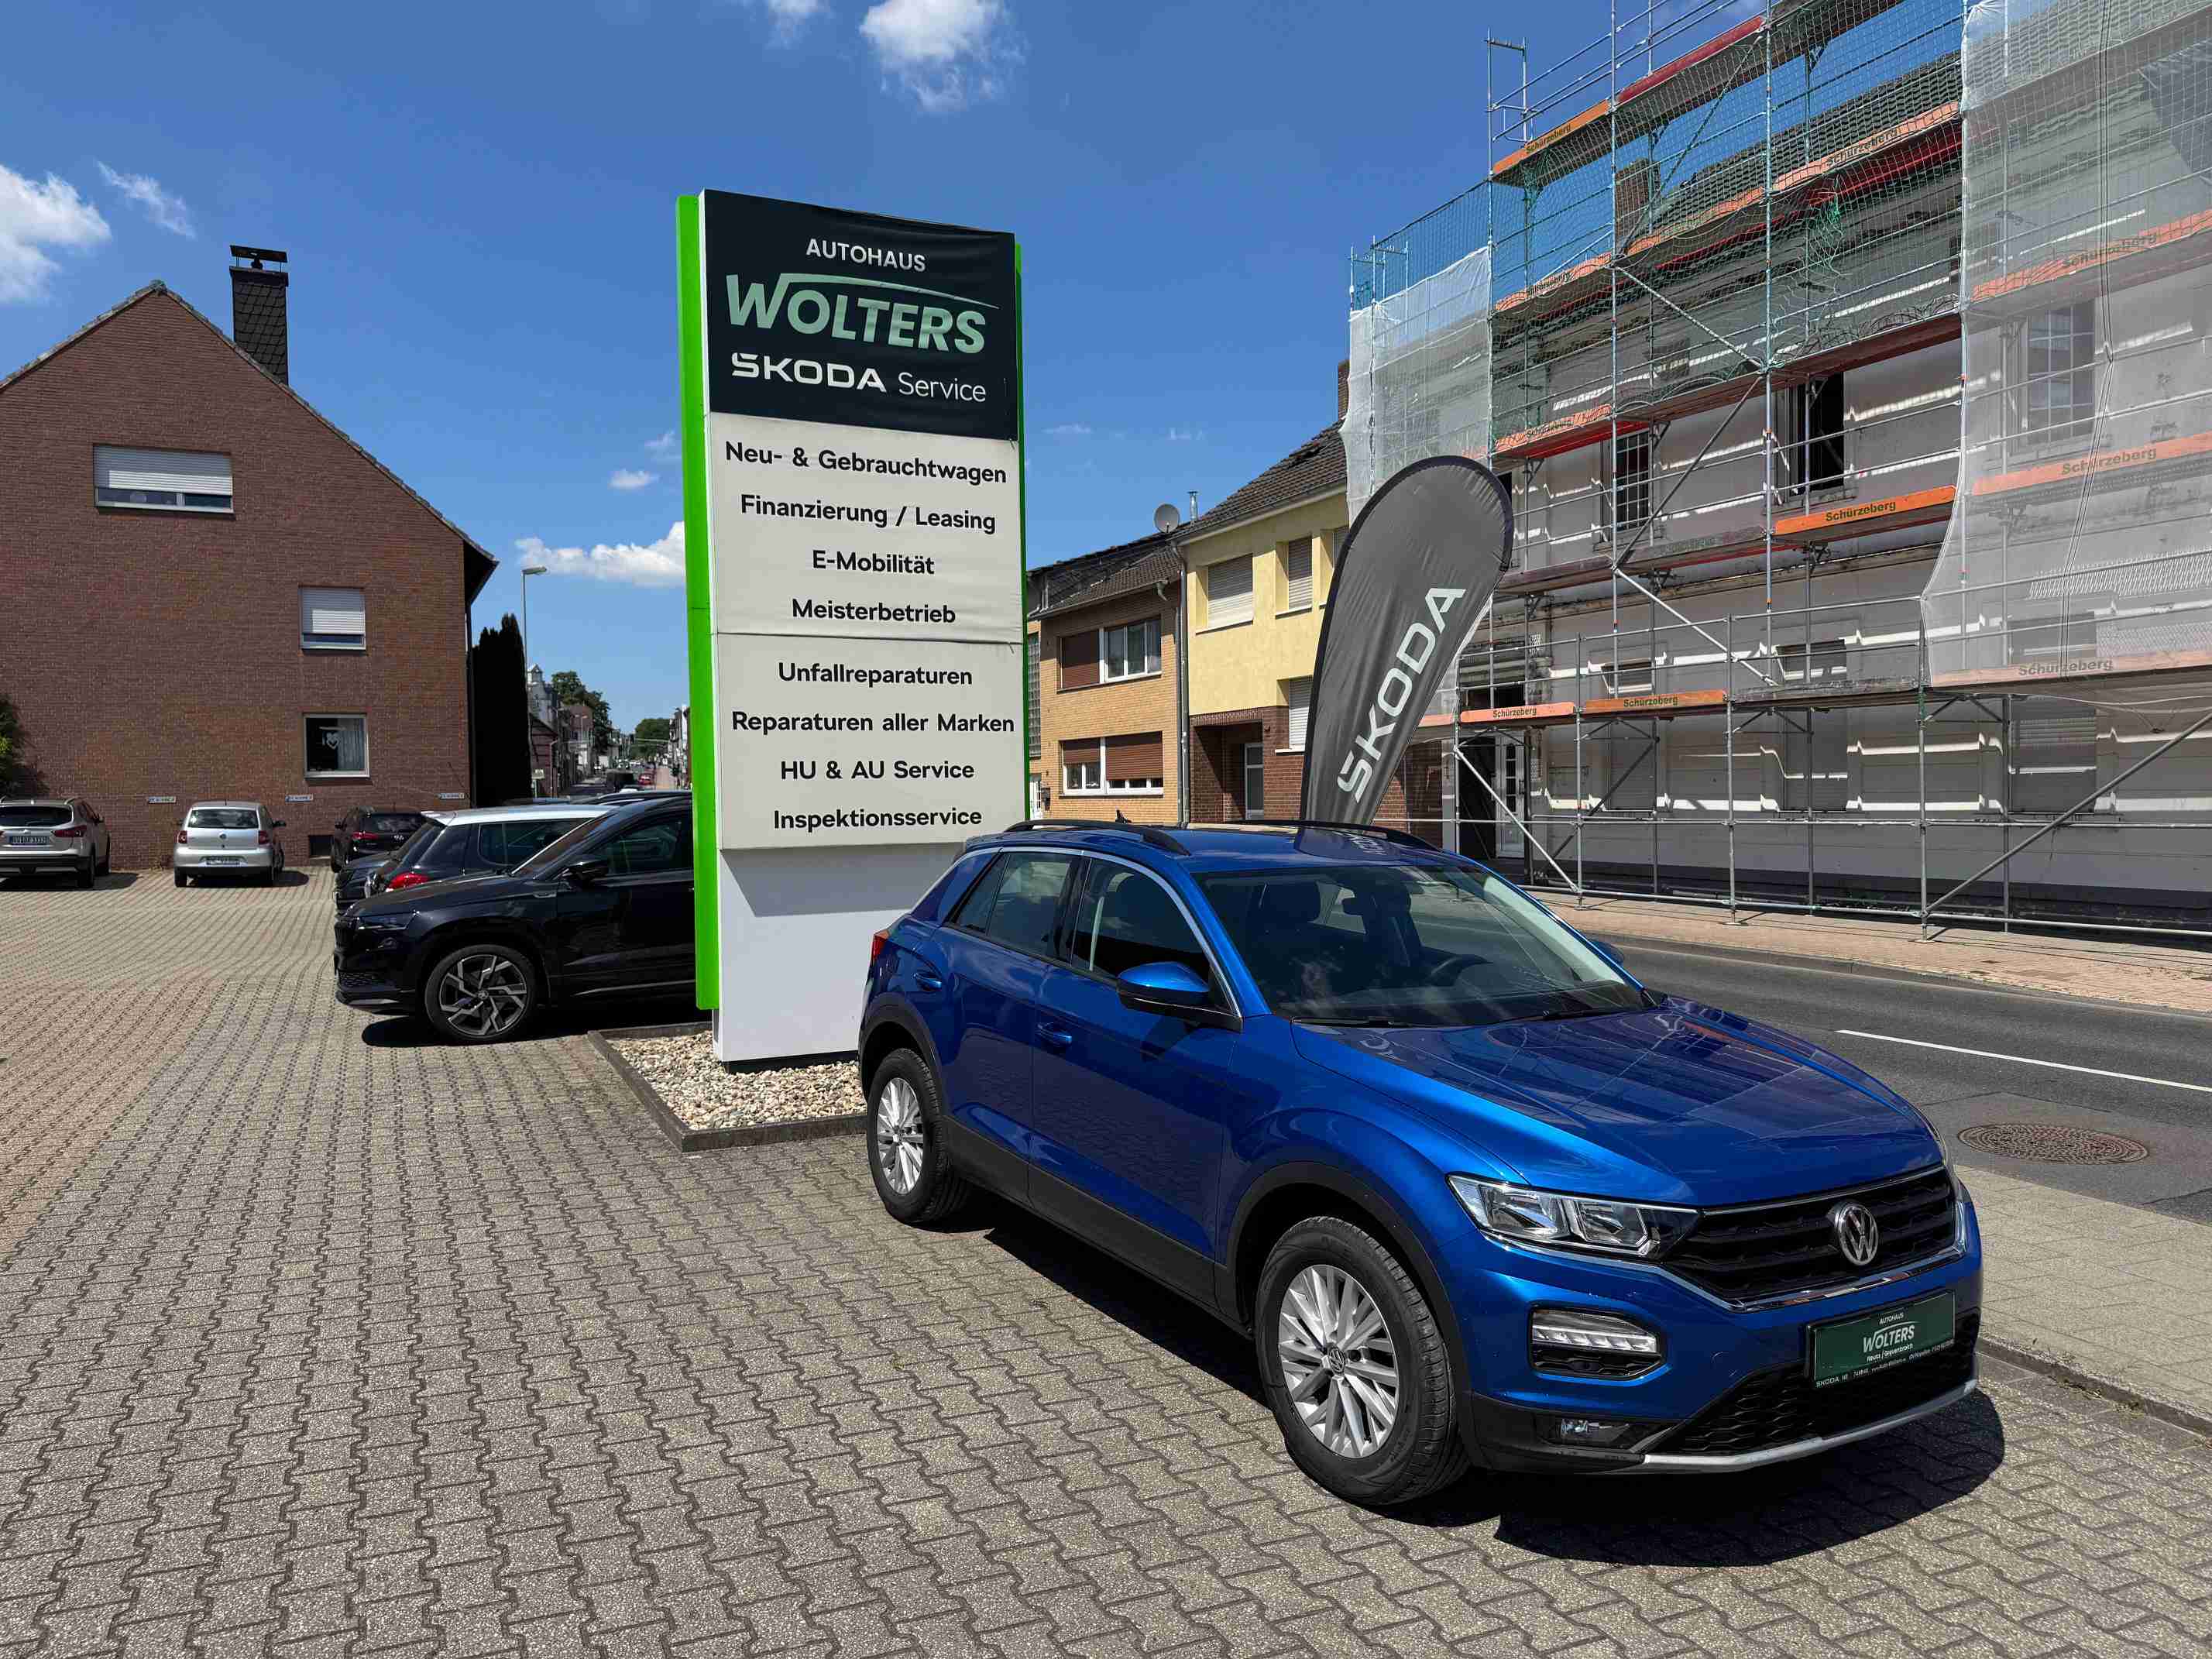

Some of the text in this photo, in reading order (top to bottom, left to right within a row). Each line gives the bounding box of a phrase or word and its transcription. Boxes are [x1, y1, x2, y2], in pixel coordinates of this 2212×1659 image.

[805, 238, 926, 272] AUTOHAUS
[726, 273, 987, 354] WOLTERS
[898, 373, 987, 402] Service
[726, 441, 1007, 486] Neu- & Gebrauchtwagen
[740, 494, 996, 534] Finanzierung / Leasing
[1826, 501, 1896, 521] Schürzeberg
[812, 549, 935, 575] E-Mobilität
[792, 598, 957, 623] Meisterbetrieb
[778, 661, 973, 688] Unfallreparaturen
[731, 710, 1015, 736] Reparaturen aller Marken
[781, 759, 975, 780] HU & AU Service
[774, 807, 982, 834] Inspektionsservice
[1879, 1312, 1904, 1325] AUTOHAUS
[1863, 1323, 1916, 1353] WOLTERS
